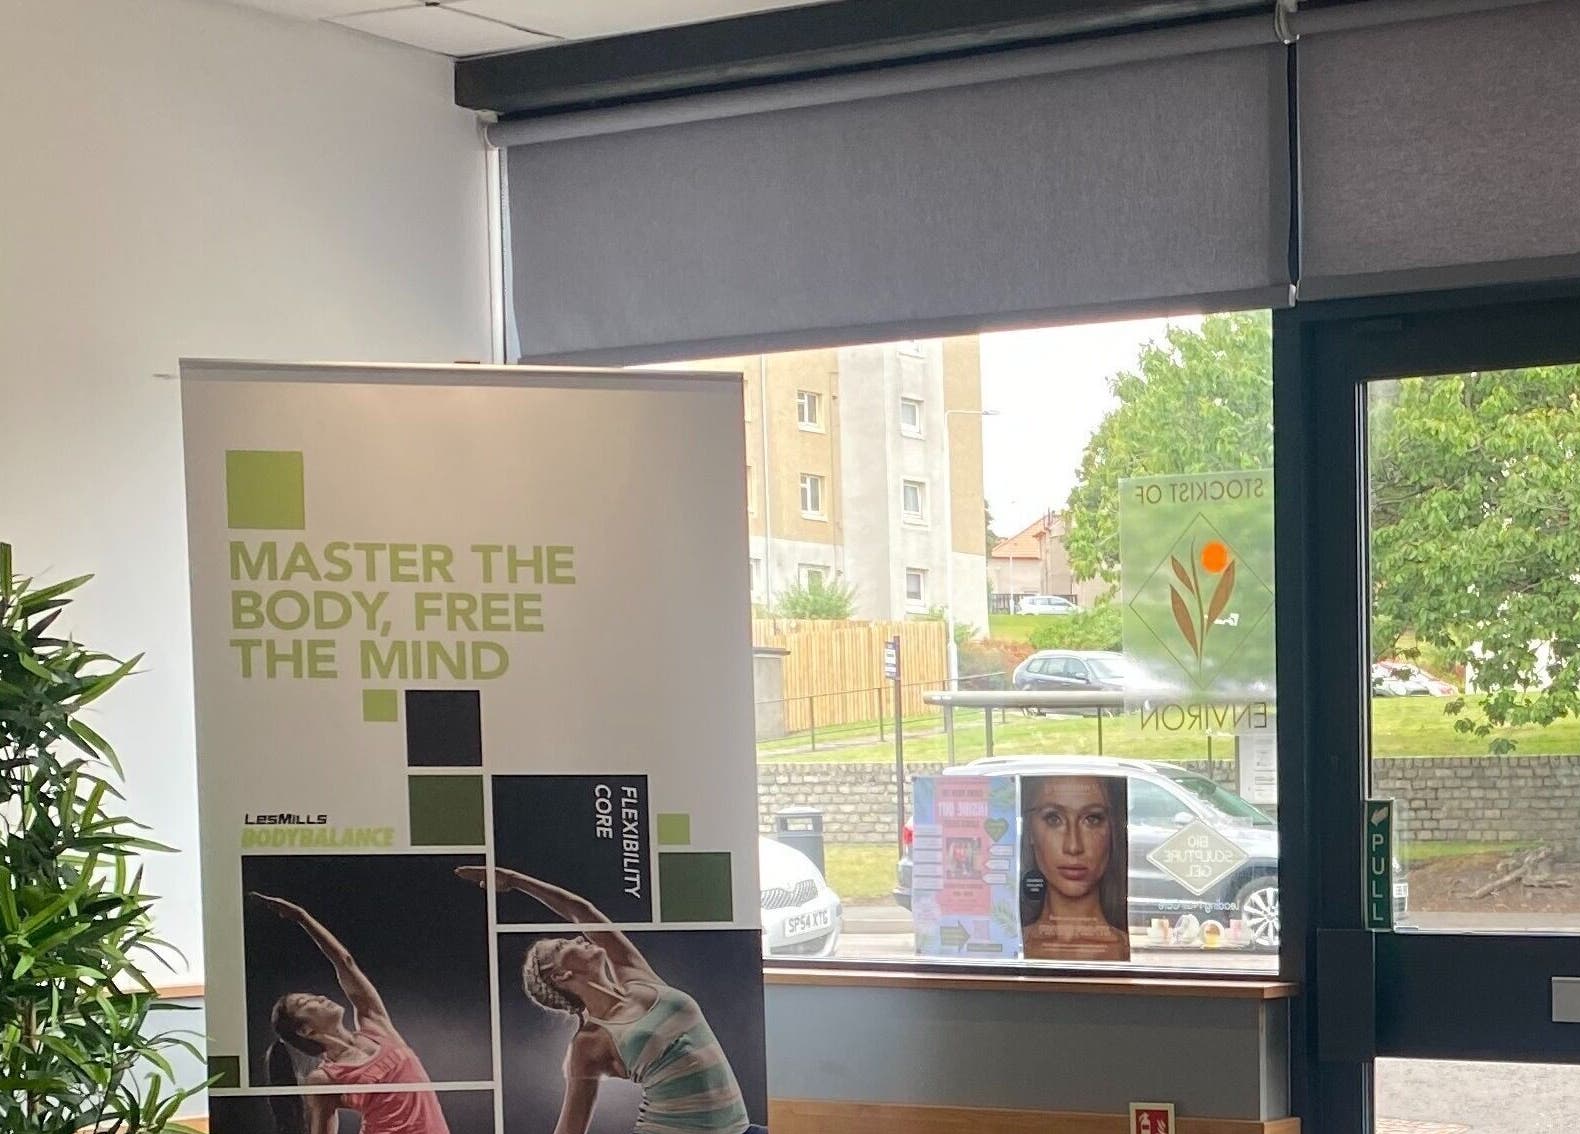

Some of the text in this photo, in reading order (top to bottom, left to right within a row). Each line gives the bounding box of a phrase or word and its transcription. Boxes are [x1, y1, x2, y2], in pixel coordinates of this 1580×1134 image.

[228, 540, 576, 585] MASTER THE
[230, 590, 544, 637] BODY, FREE
[230, 638, 510, 681] THE MIND
[594, 784, 613, 839] CORE
[241, 827, 395, 848] BODYBALANCE
[620, 786, 640, 899] FLEXIBILITY
[1372, 834, 1385, 921] PULL
